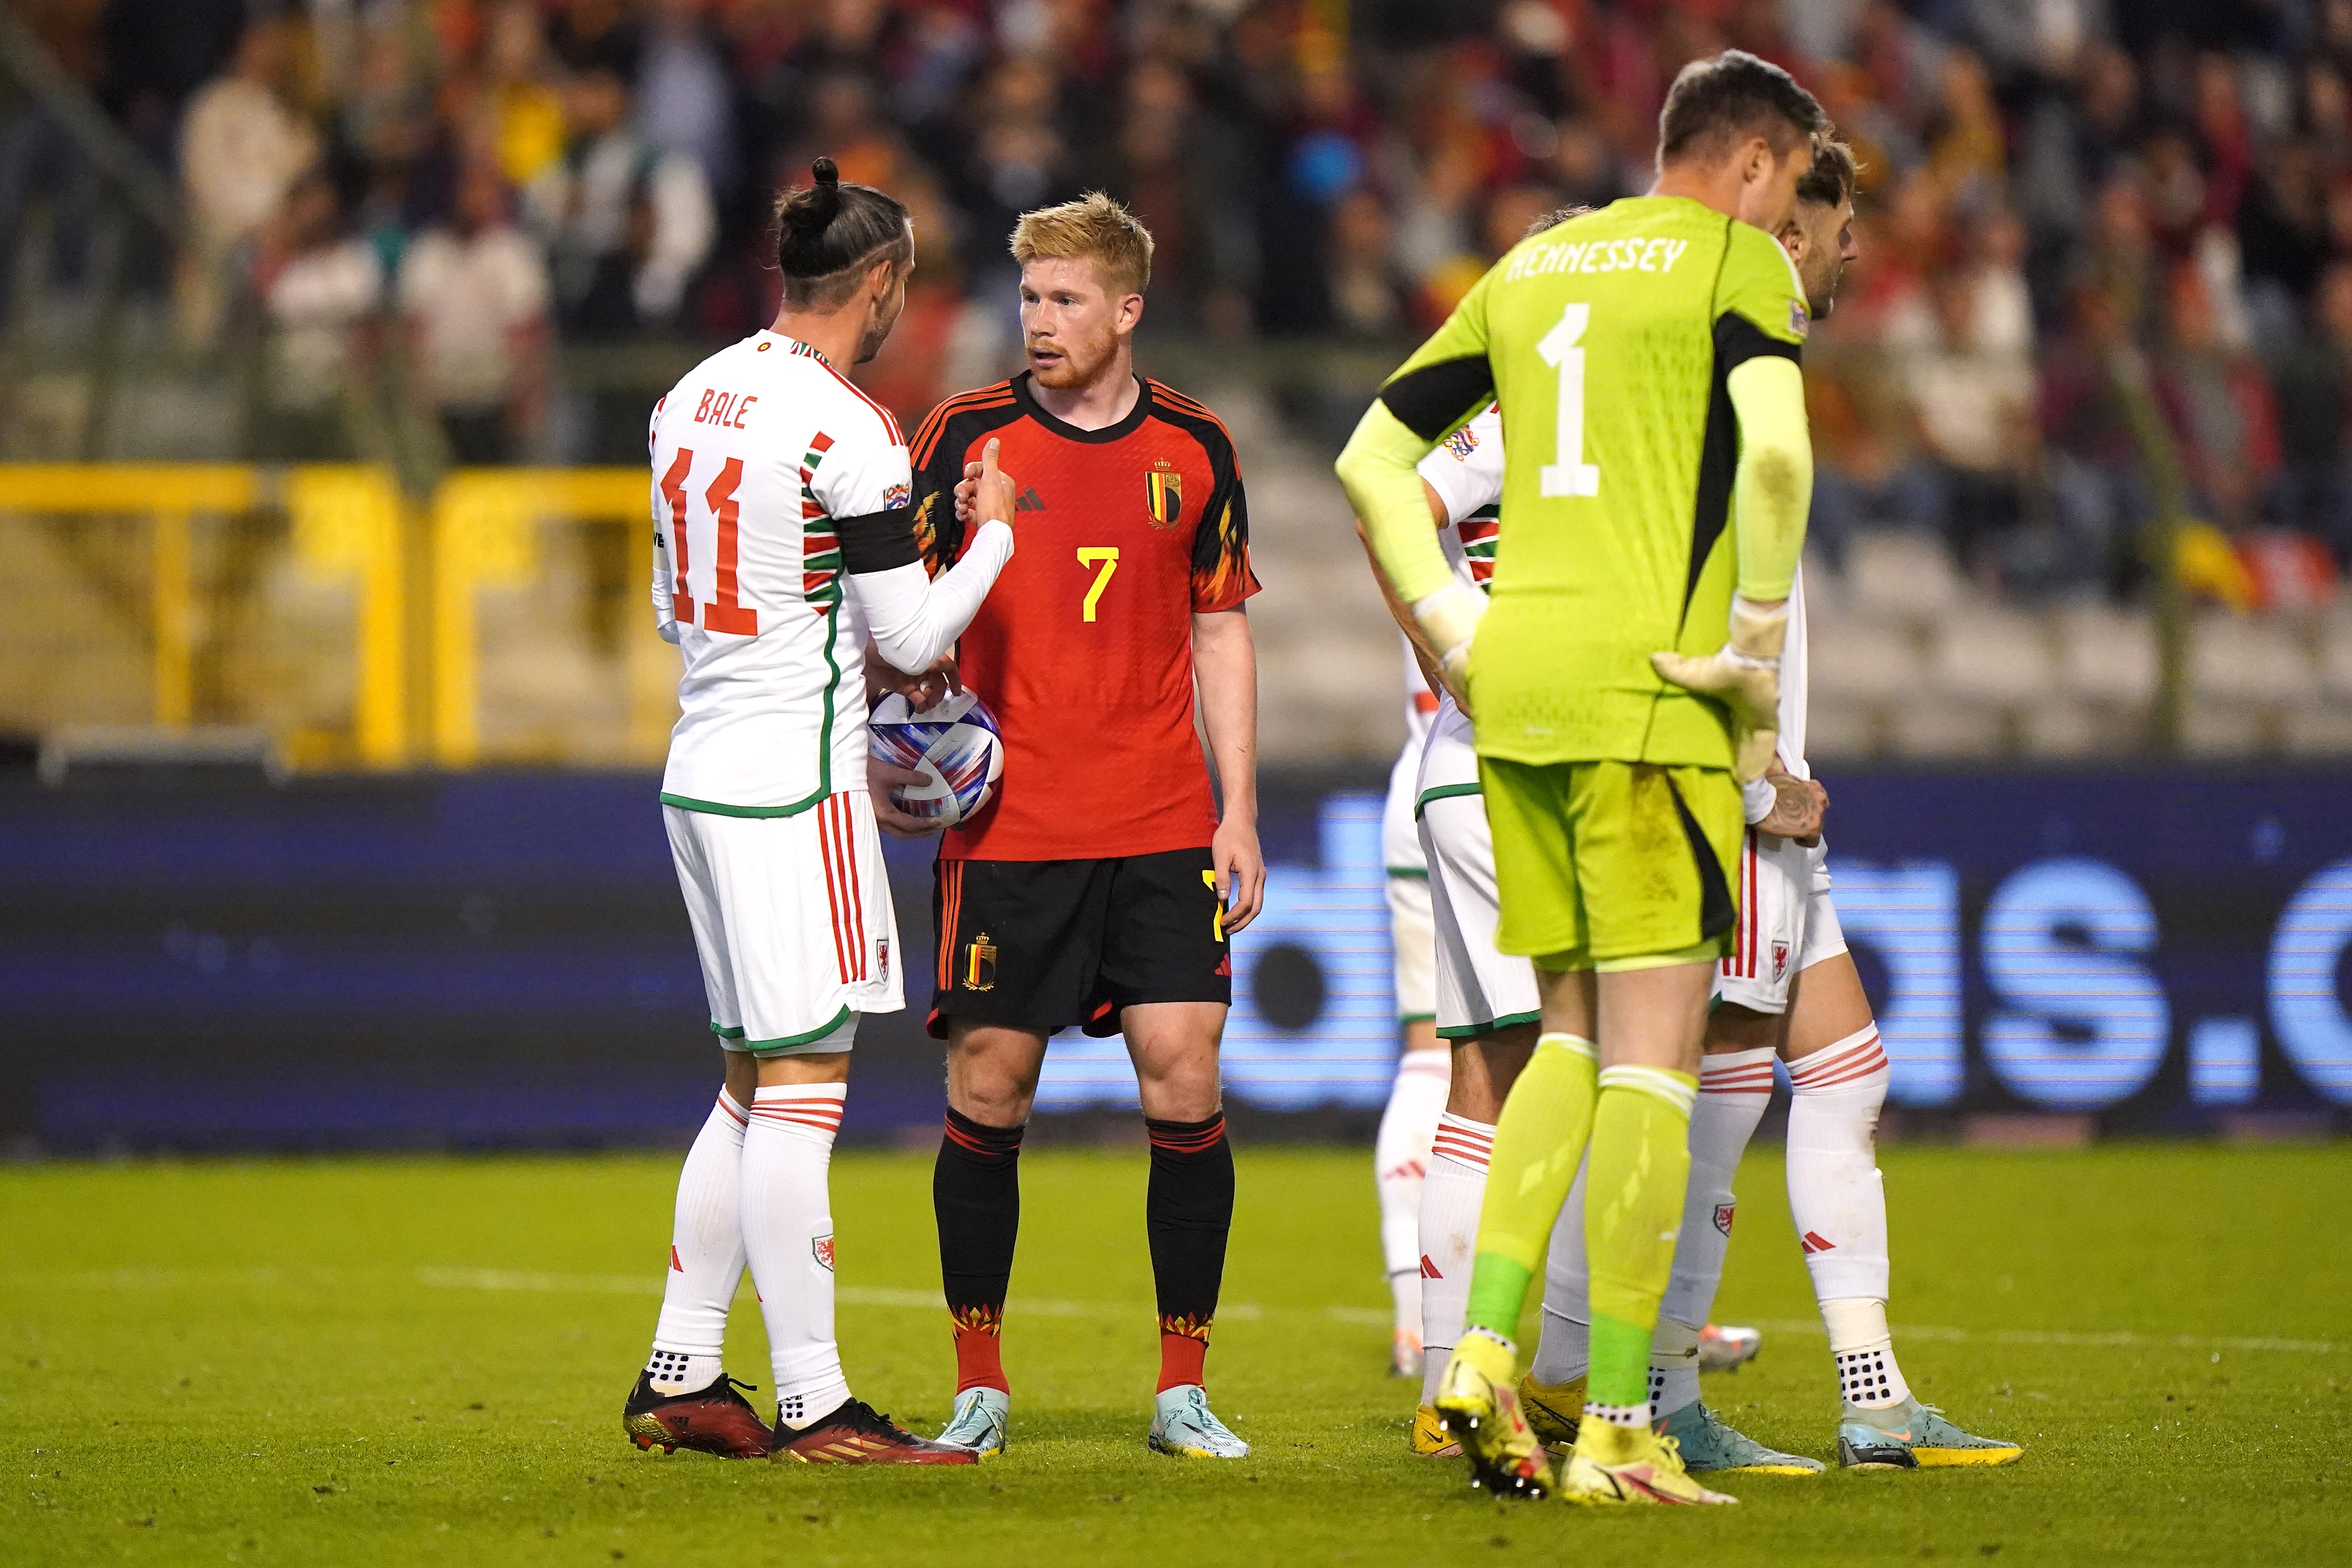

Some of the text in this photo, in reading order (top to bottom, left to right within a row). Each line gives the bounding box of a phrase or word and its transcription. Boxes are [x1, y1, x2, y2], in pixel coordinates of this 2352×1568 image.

[1506, 237, 1687, 283] HENNESSEY
[694, 389, 758, 429] BALE
[1536, 303, 1600, 498] 1
[653, 531, 665, 548] VE
[660, 447, 758, 636] 11
[1077, 547, 1119, 622] 7
